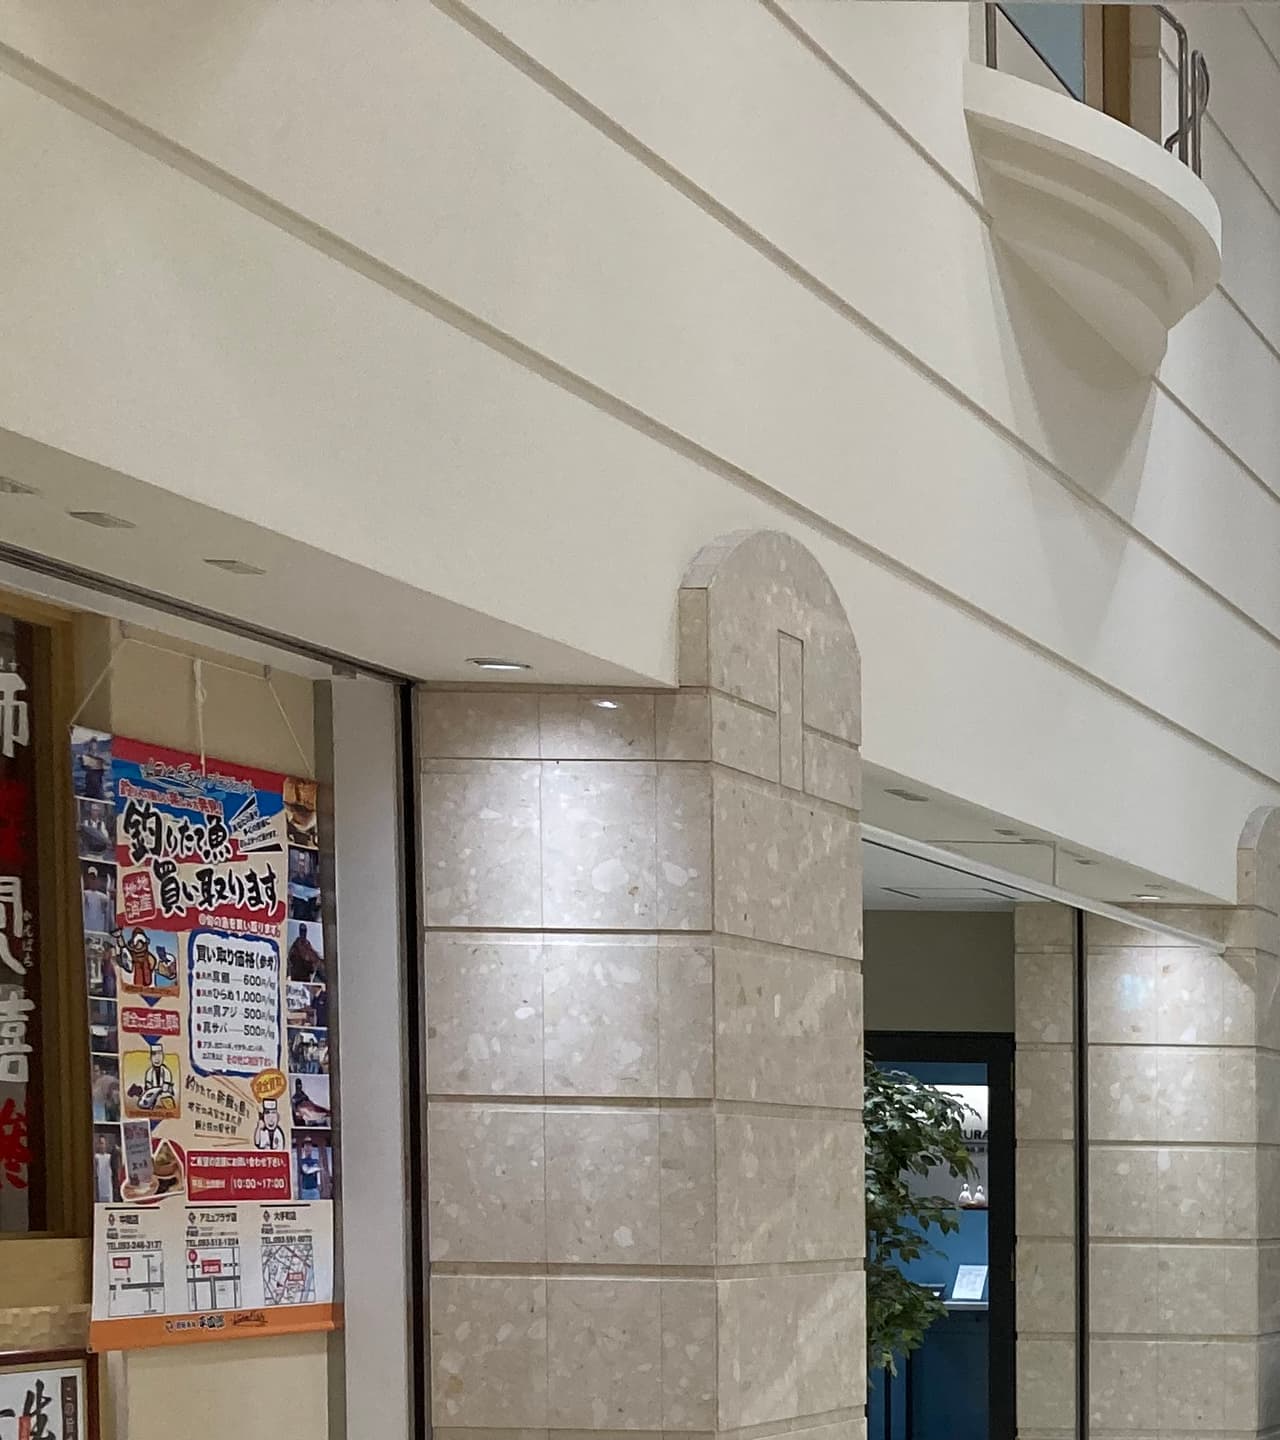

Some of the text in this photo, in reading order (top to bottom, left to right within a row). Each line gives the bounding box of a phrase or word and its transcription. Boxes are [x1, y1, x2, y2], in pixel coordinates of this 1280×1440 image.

[123, 800, 231, 863] 釣りたて魚
[153, 860, 277, 915] 買い取ります
